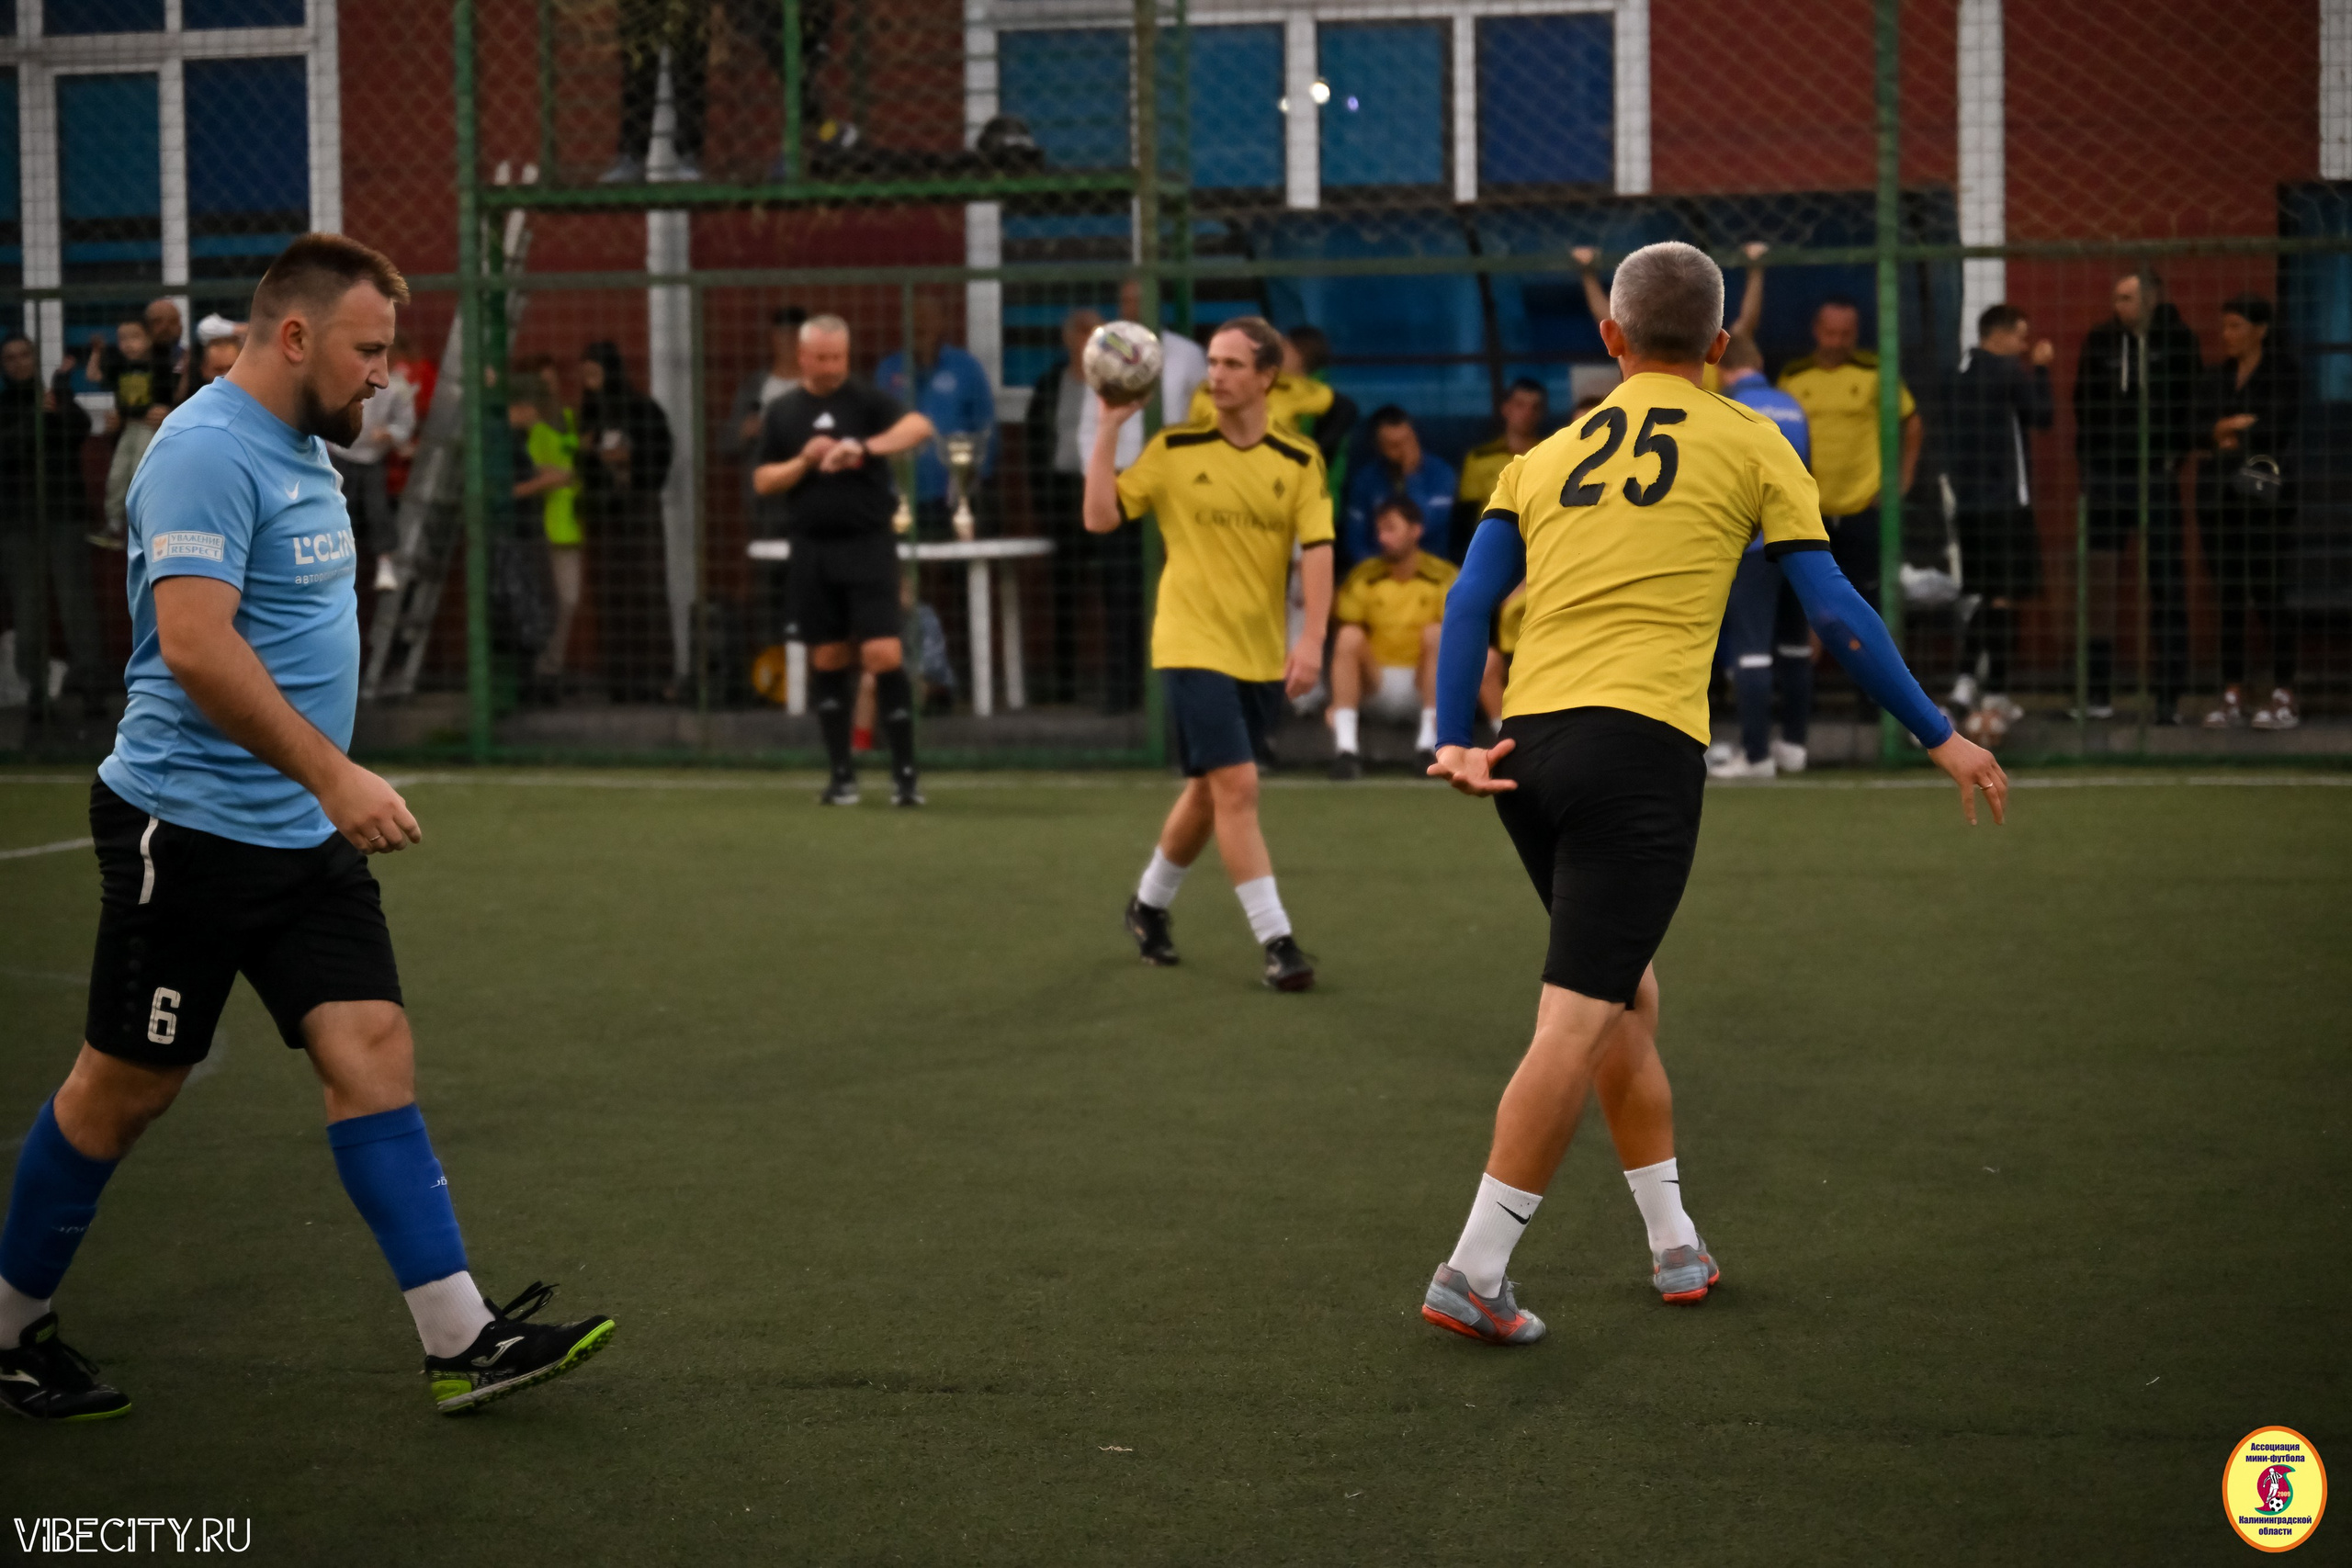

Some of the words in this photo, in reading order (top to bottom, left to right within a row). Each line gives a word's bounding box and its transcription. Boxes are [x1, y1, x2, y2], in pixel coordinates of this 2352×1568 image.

[1559, 406, 1688, 508] 25
[171, 534, 220, 547] УВАЖЕНИЕ
[171, 546, 220, 558] RESPECT
[147, 987, 181, 1045] 6
